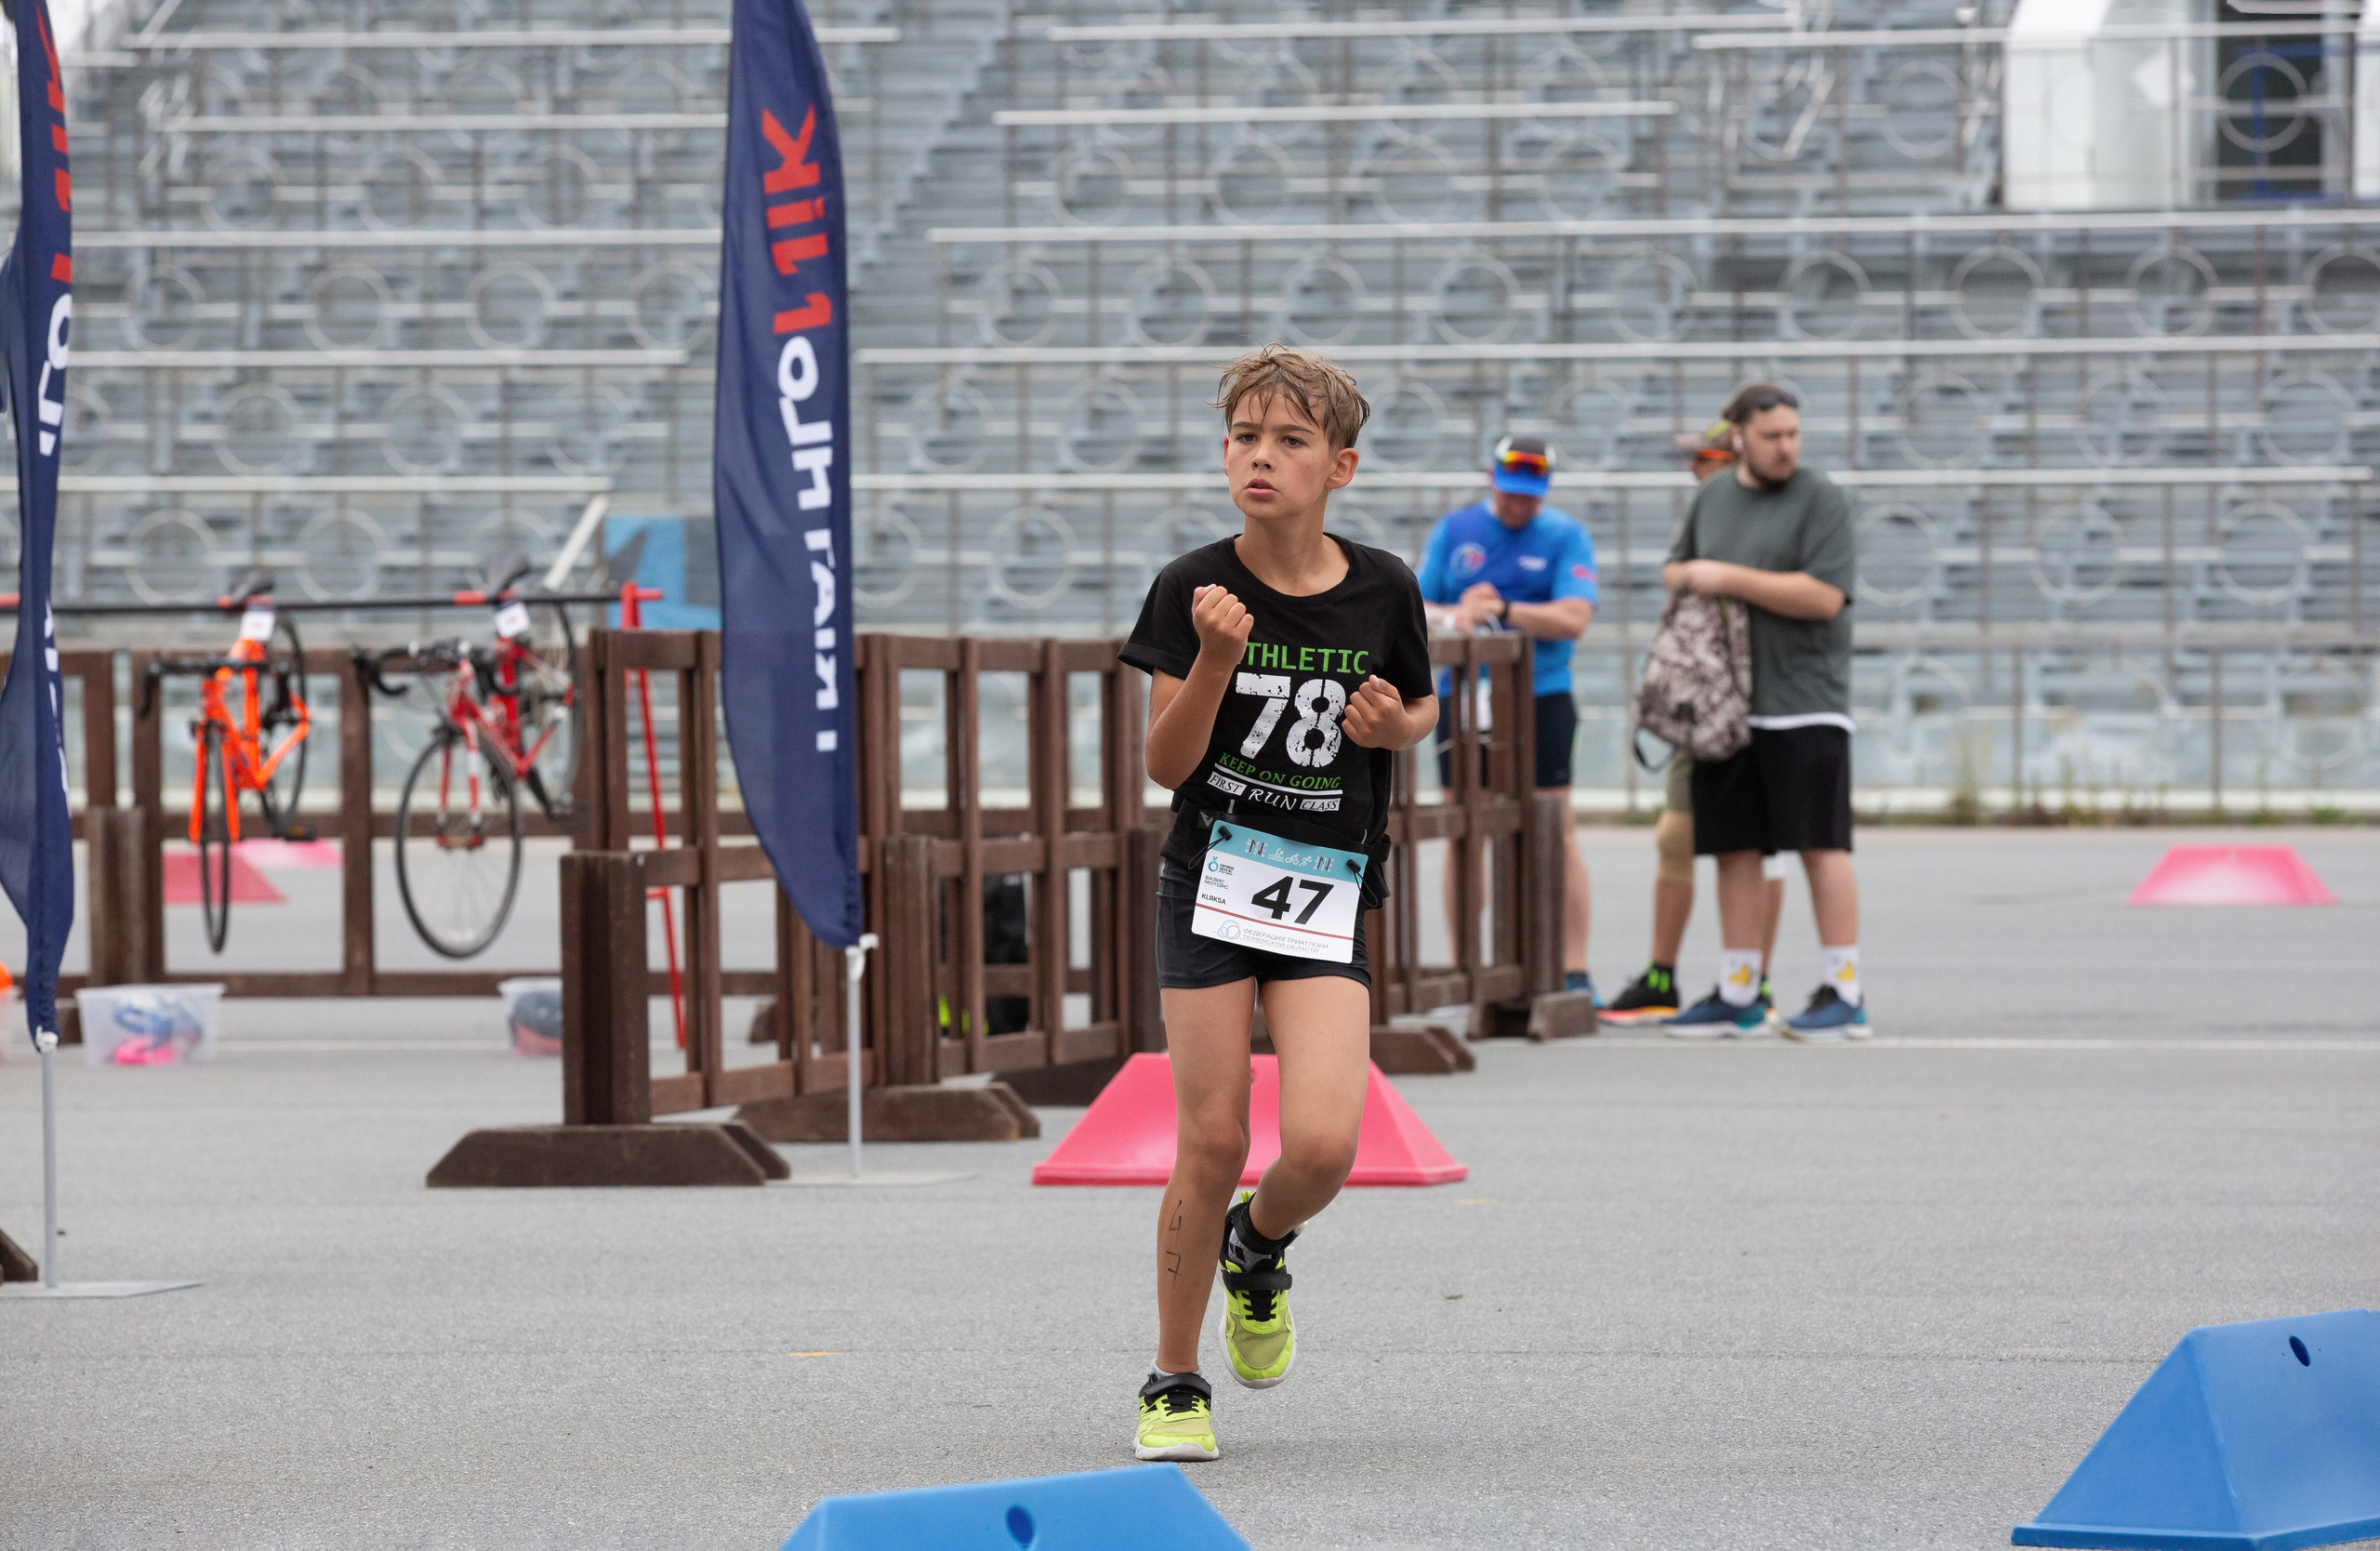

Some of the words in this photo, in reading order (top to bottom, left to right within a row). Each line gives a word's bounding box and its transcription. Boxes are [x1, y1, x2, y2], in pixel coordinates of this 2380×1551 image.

[1237, 642, 1368, 674] THLETIC
[1236, 671, 1346, 768] 78
[1219, 752, 1256, 776] KEEP
[1259, 770, 1286, 785] ON
[1289, 775, 1341, 789] GOING
[1209, 775, 1243, 793] FIRST
[1248, 789, 1297, 811] RUN
[1302, 799, 1339, 810] CLASS
[1204, 880, 1229, 890] МОТОРС
[1250, 875, 1334, 925] 47
[1242, 934, 1285, 948] ТЮМЕНСКОЙ
[1286, 943, 1319, 953] ОБЛАСТИ
[1243, 928, 1287, 942] ФЕДЕРАЦИЯ
[1287, 937, 1329, 949] ТРИАТЛОНА
